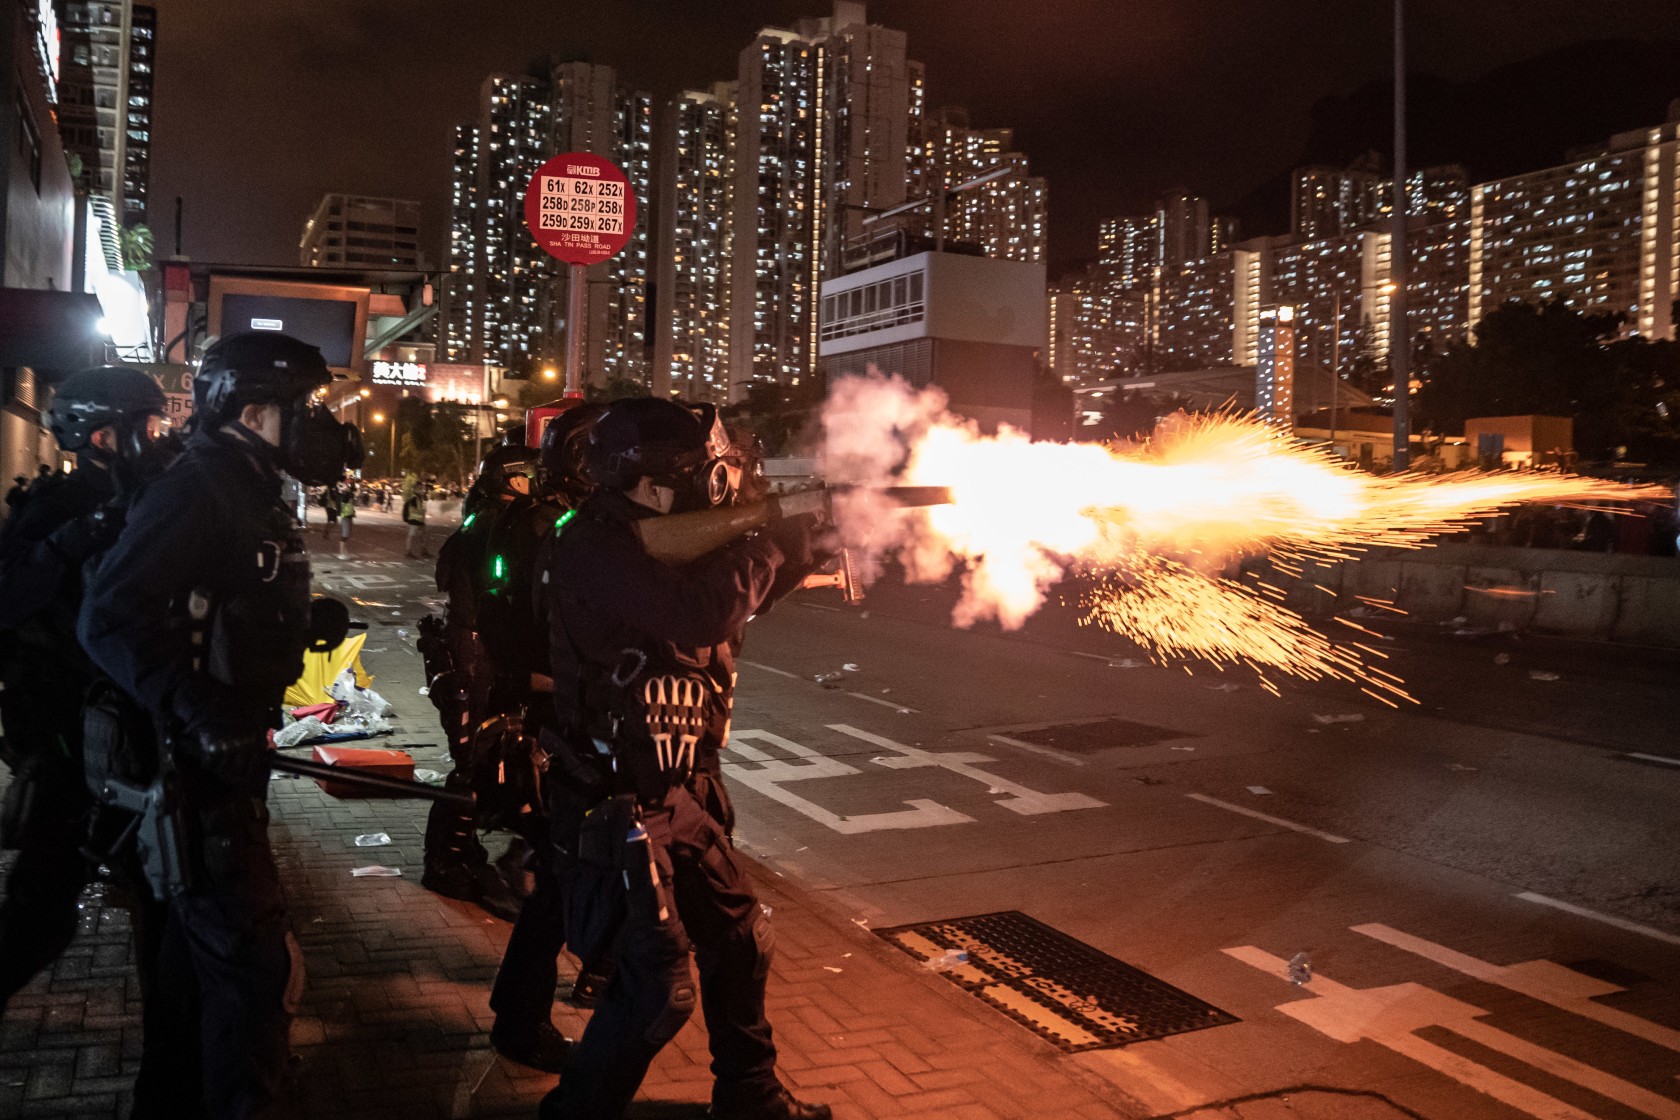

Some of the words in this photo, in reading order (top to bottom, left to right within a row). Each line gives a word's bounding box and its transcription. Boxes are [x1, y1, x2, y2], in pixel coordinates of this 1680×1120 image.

[576, 165, 600, 176] KMB
[547, 179, 565, 193] 61X
[574, 181, 593, 195] 62X
[598, 183, 623, 197] 252X
[542, 196, 568, 211] 258D
[570, 198, 596, 212] 258P
[598, 200, 623, 215] 258X
[542, 214, 568, 228] 259D
[570, 215, 595, 230] 259X
[597, 218, 623, 232] 267X
[561, 233, 600, 244] 沙田坳道
